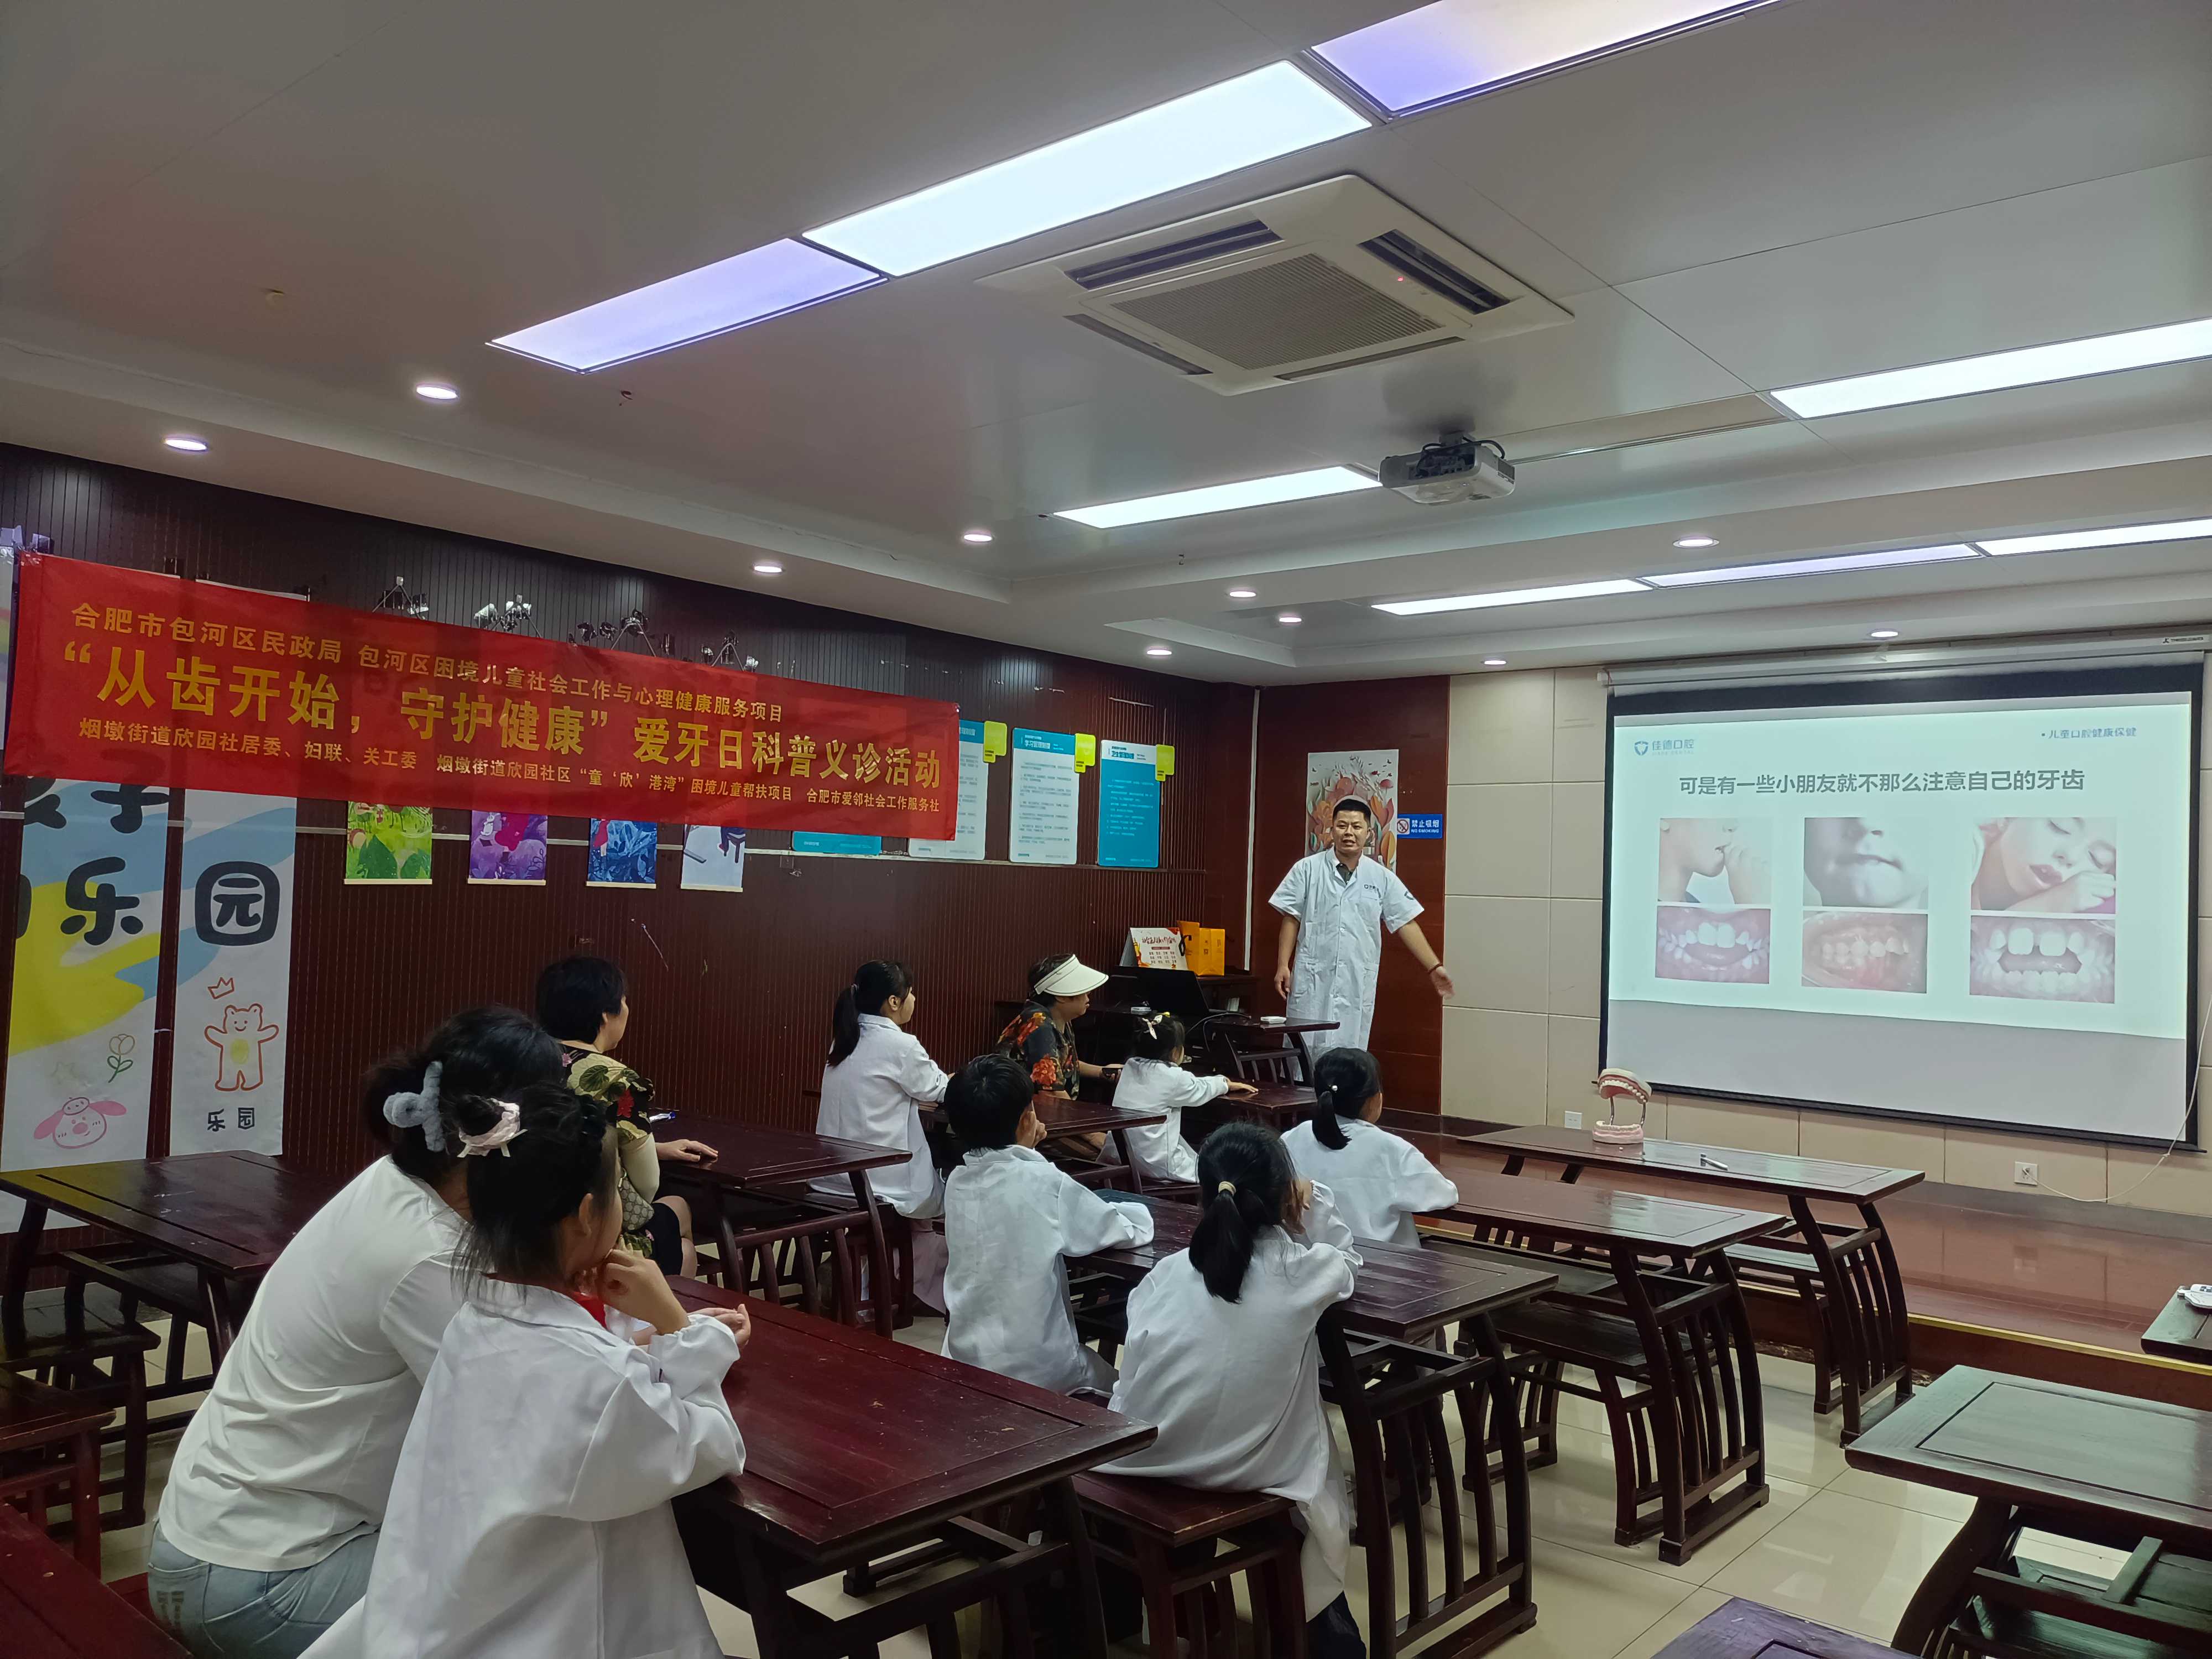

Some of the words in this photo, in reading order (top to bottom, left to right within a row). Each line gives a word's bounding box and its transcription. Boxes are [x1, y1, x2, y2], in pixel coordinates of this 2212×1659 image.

[71, 602, 342, 664] 合肥市包河区民政局
[358, 644, 782, 722] 包河区困境儿童社会工作与心理健康服务项目
[1652, 739, 1694, 750] 佳德口腔
[1678, 769, 2085, 795] 可是有一些小朋友就不那么注意自己的牙齿
[806, 787, 940, 812] 合肥市爱邻社会工作服务社
[1411, 820, 1439, 828] 禁止吸烟
[207, 1107, 255, 1132] 乐园
